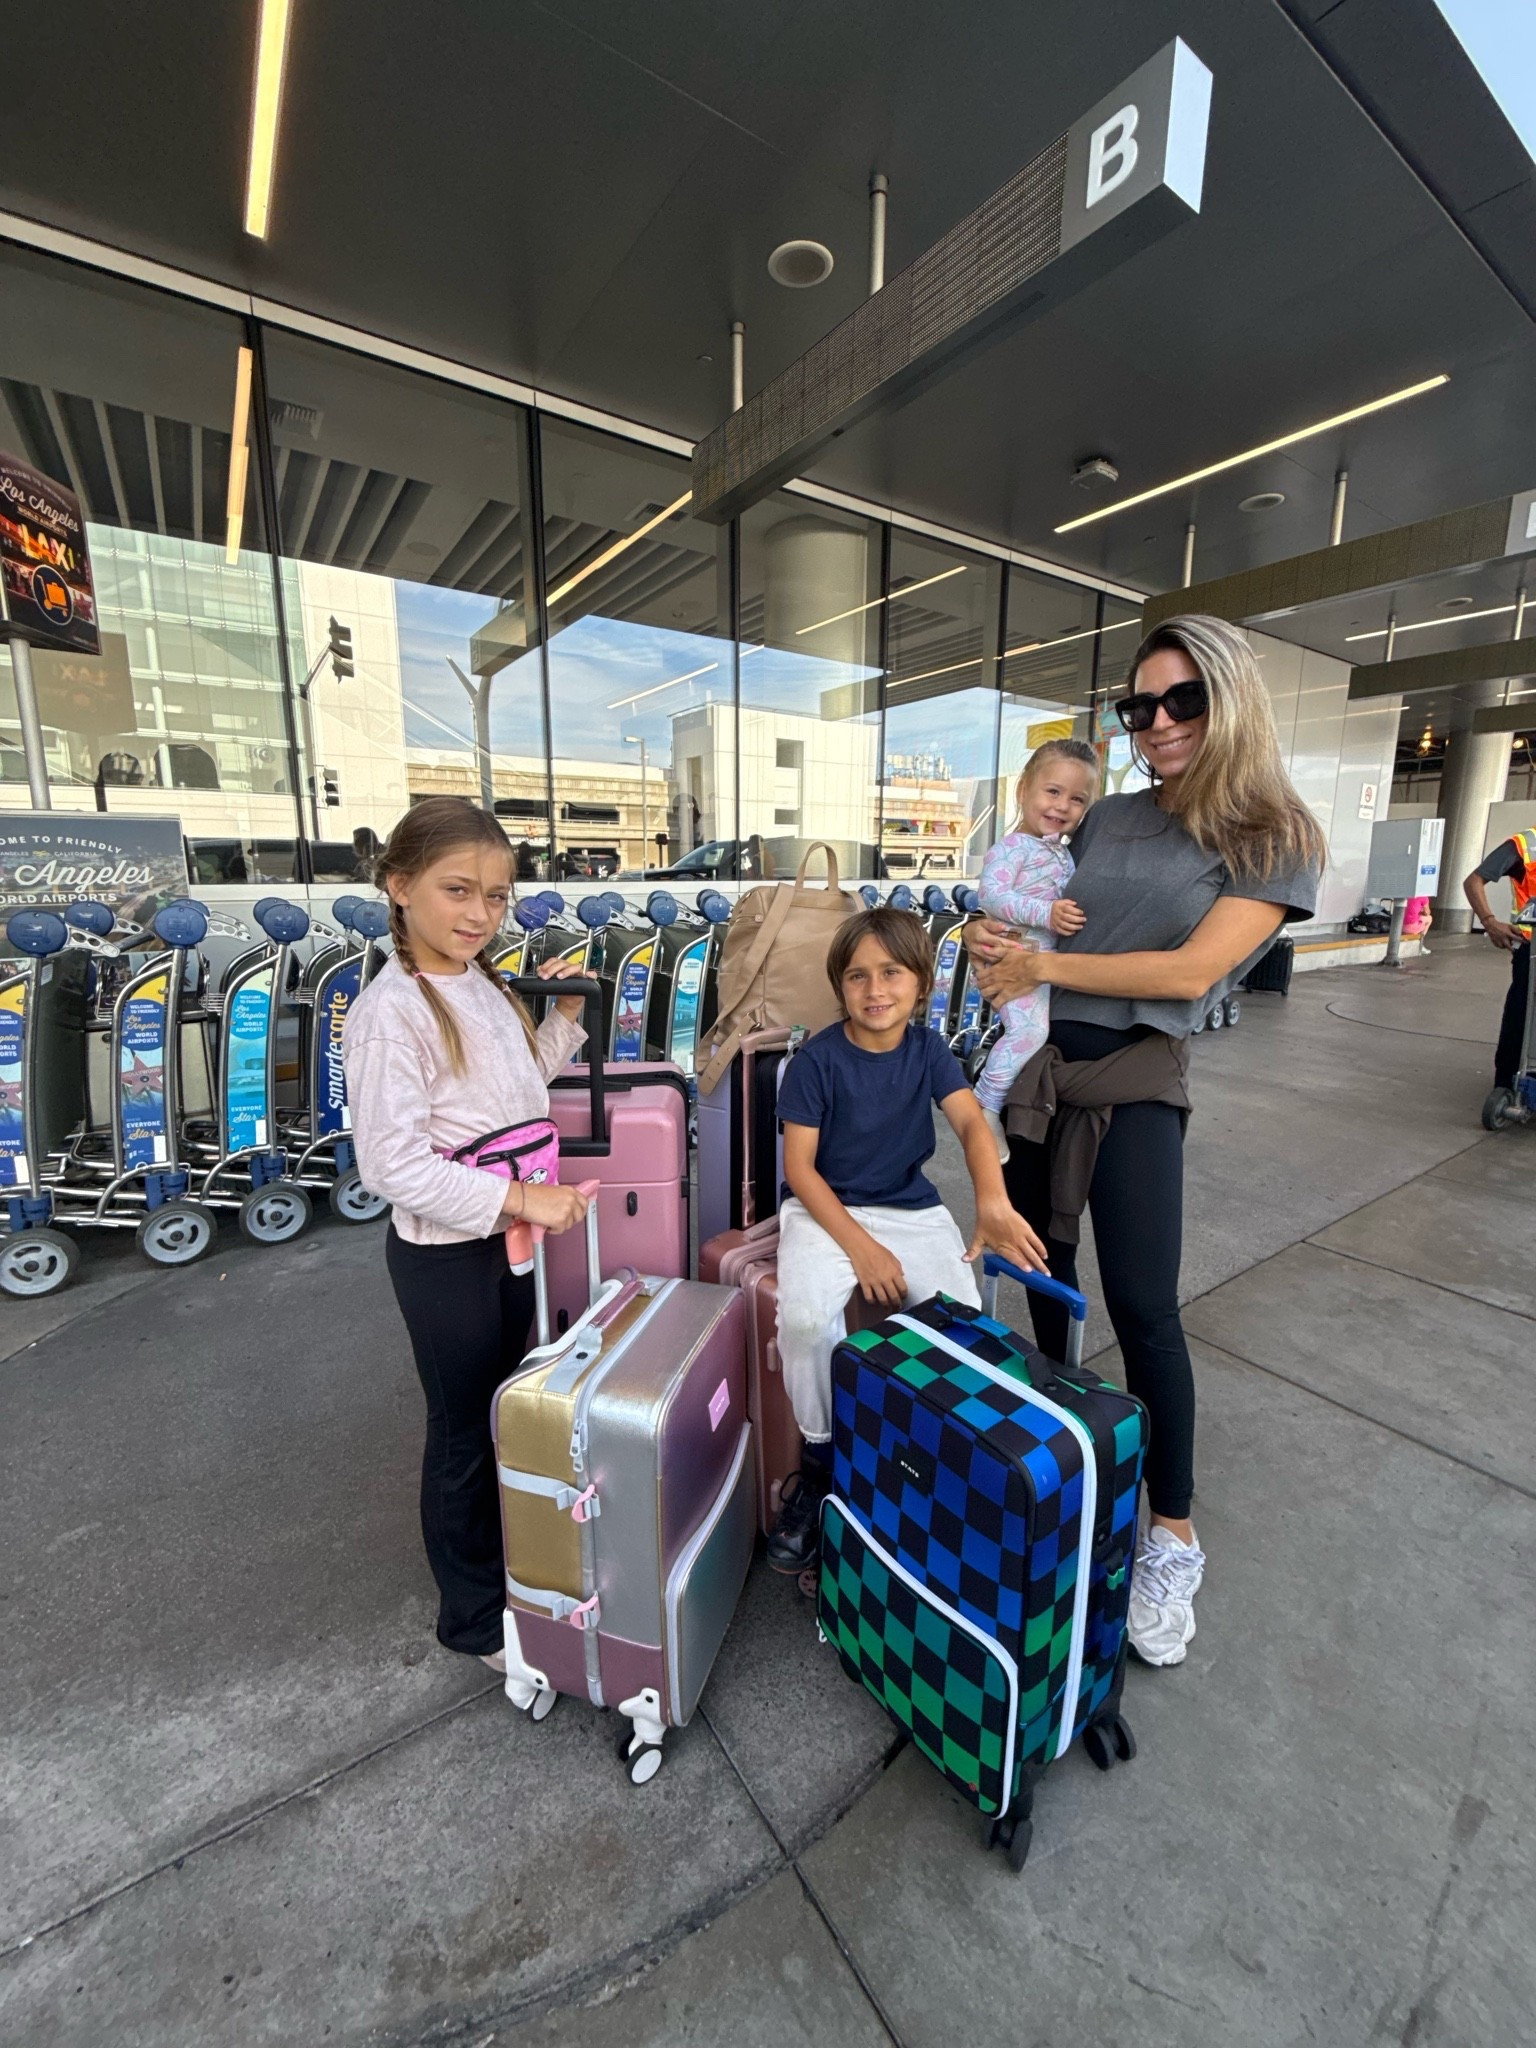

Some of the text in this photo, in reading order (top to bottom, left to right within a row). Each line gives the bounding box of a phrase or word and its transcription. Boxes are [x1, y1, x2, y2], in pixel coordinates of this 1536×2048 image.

[1086, 104, 1139, 209] B
[0, 475, 26, 502] Los
[29, 495, 79, 532] Angeles
[32, 835, 51, 843] TO
[57, 836, 122, 854] FRIENDLY
[15, 859, 154, 893] Angeles
[0, 893, 117, 904] ORLD AIRPORTS
[325, 991, 349, 1111] smartecarte
[126, 1120, 161, 1128] EVERYONE
